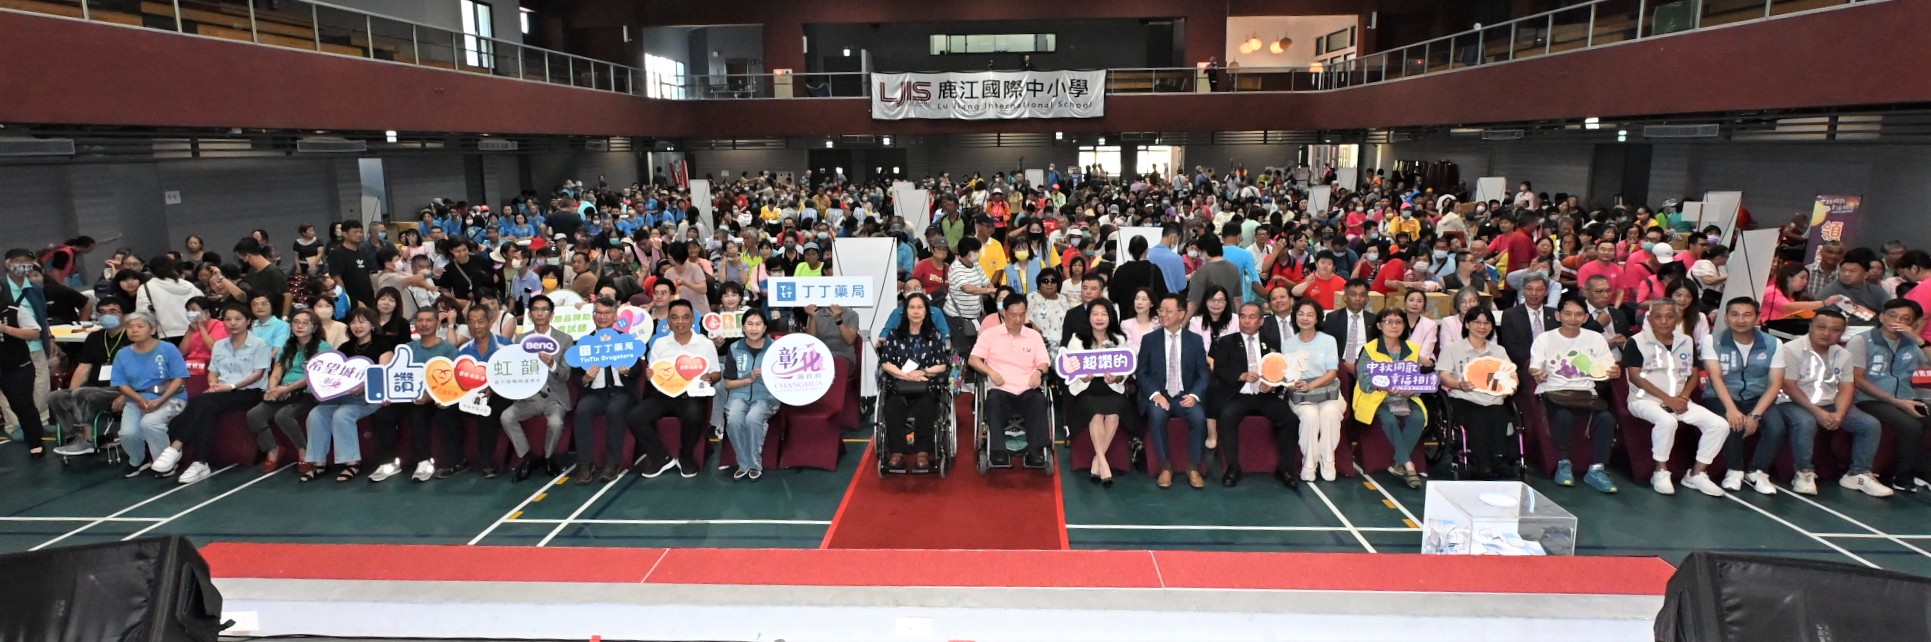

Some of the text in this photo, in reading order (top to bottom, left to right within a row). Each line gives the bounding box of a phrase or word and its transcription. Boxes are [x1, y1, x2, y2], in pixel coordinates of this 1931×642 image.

[880, 81, 931, 107] LJIS
[938, 79, 1088, 99] 鹿江國際中小學
[985, 101, 1053, 109] International
[1058, 100, 1092, 109] School
[1821, 220, 1844, 241] 領
[802, 285, 864, 298] 丁丁藥局
[525, 341, 555, 351] BenQ
[594, 342, 634, 354] 丁丁藥局
[494, 360, 540, 375] 虹韻
[1083, 354, 1127, 370] 超讚的
[393, 372, 414, 392] 讚
